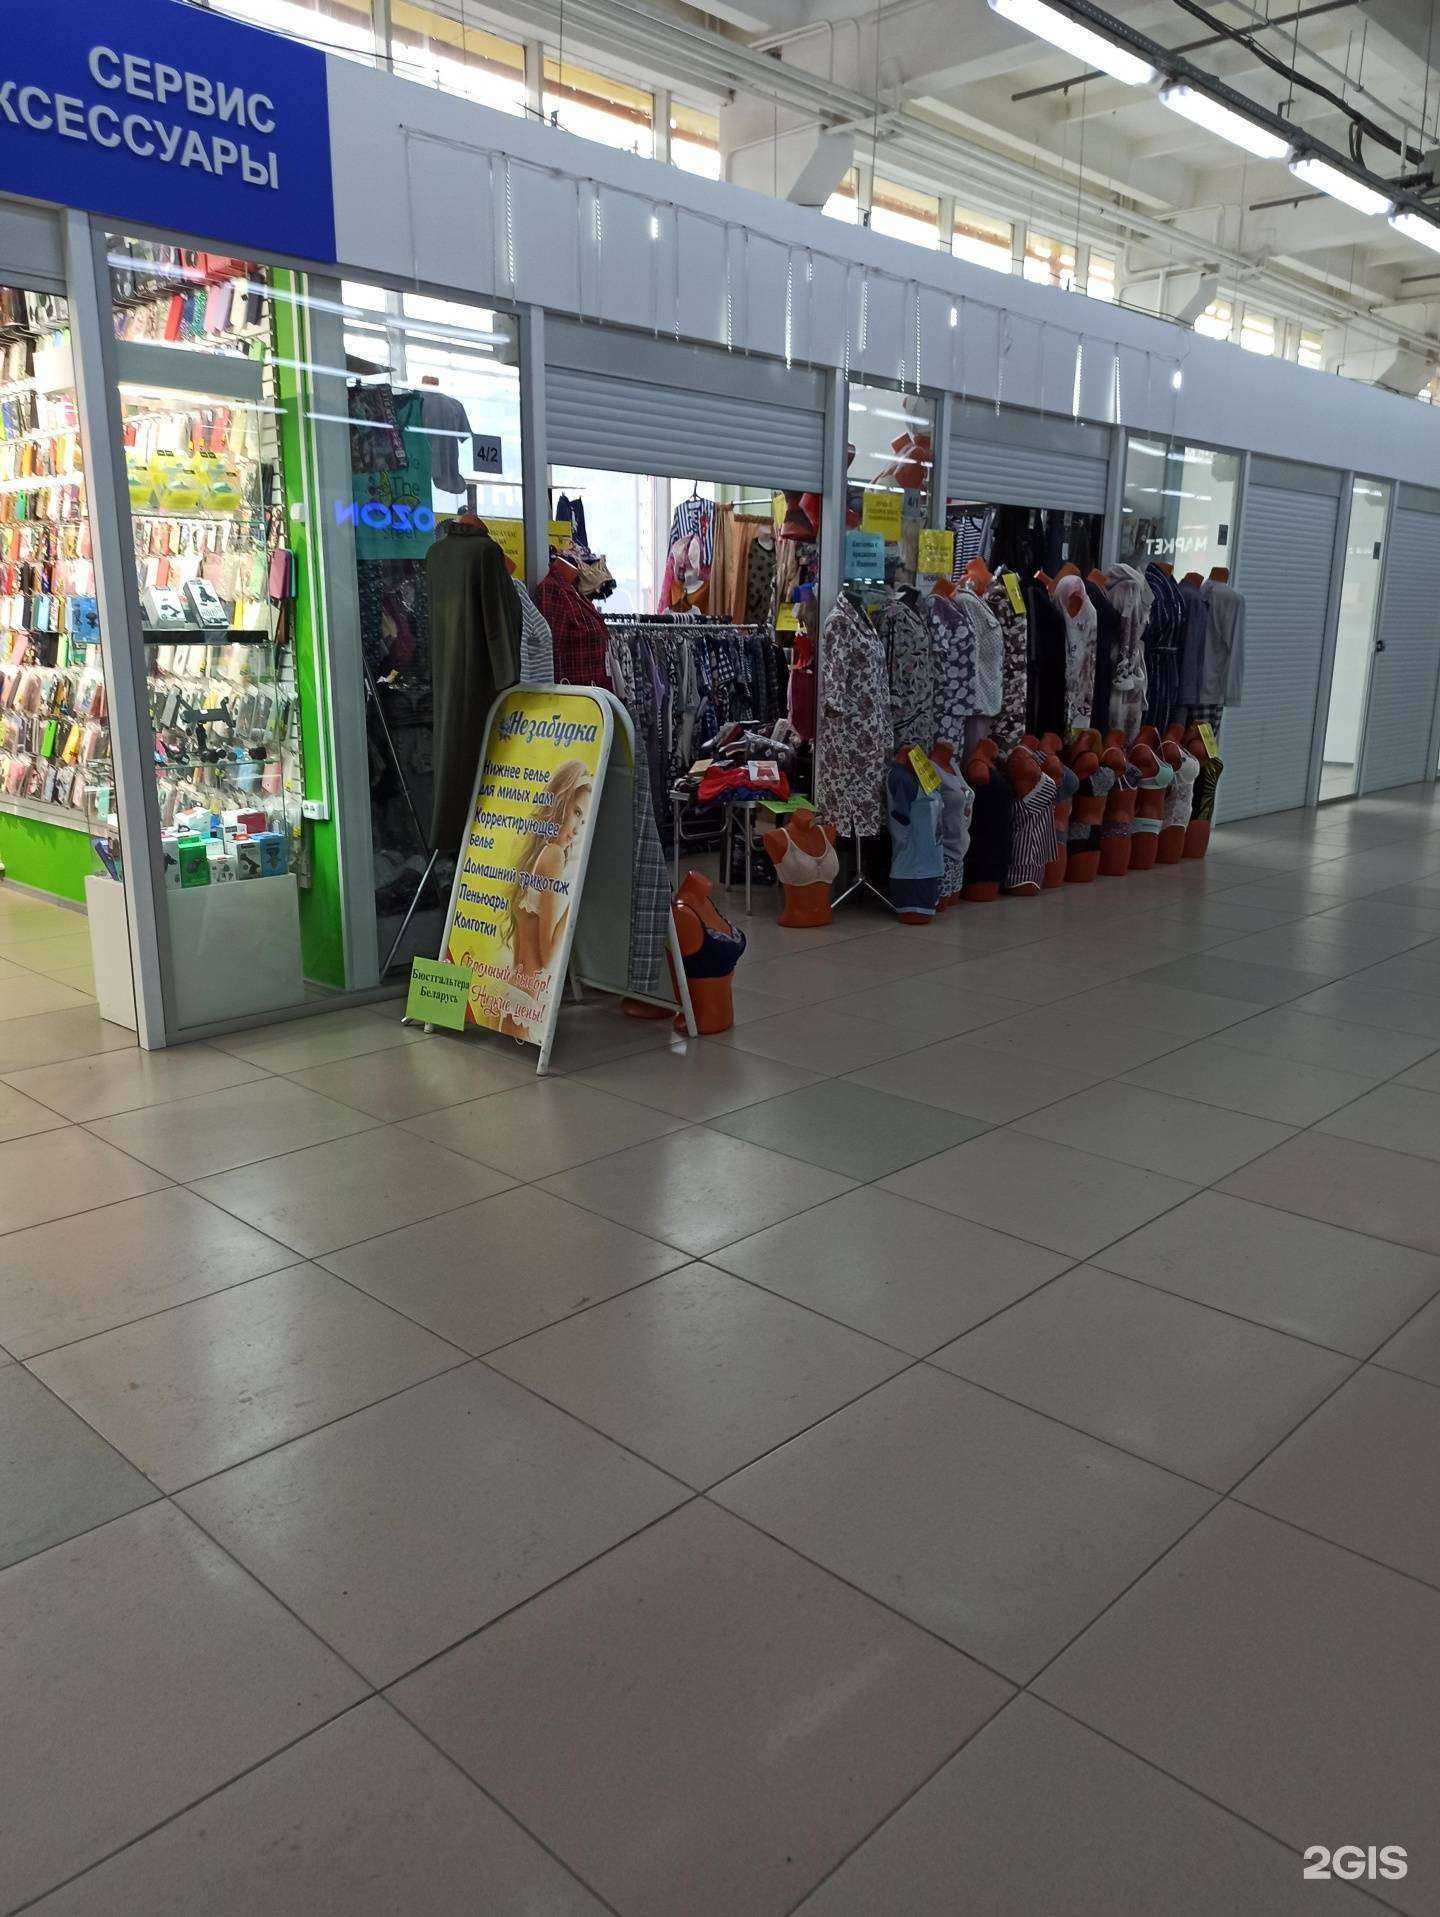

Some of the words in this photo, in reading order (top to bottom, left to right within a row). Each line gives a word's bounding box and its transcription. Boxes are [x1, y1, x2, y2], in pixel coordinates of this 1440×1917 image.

[88, 45, 277, 134] СЕРВИС
[477, 446, 499, 462] 4/2
[508, 710, 598, 747] Незабудка
[483, 760, 521, 778] Нижнее
[497, 786, 531, 802] милых
[532, 792, 553, 806] дам
[475, 806, 560, 837] Корректирующее
[464, 857, 516, 882] Домашний
[519, 871, 570, 895] трикотаж
[459, 883, 509, 911] Пеньюары
[454, 911, 497, 936] Колготки
[420, 985, 459, 1004] Беларусь
